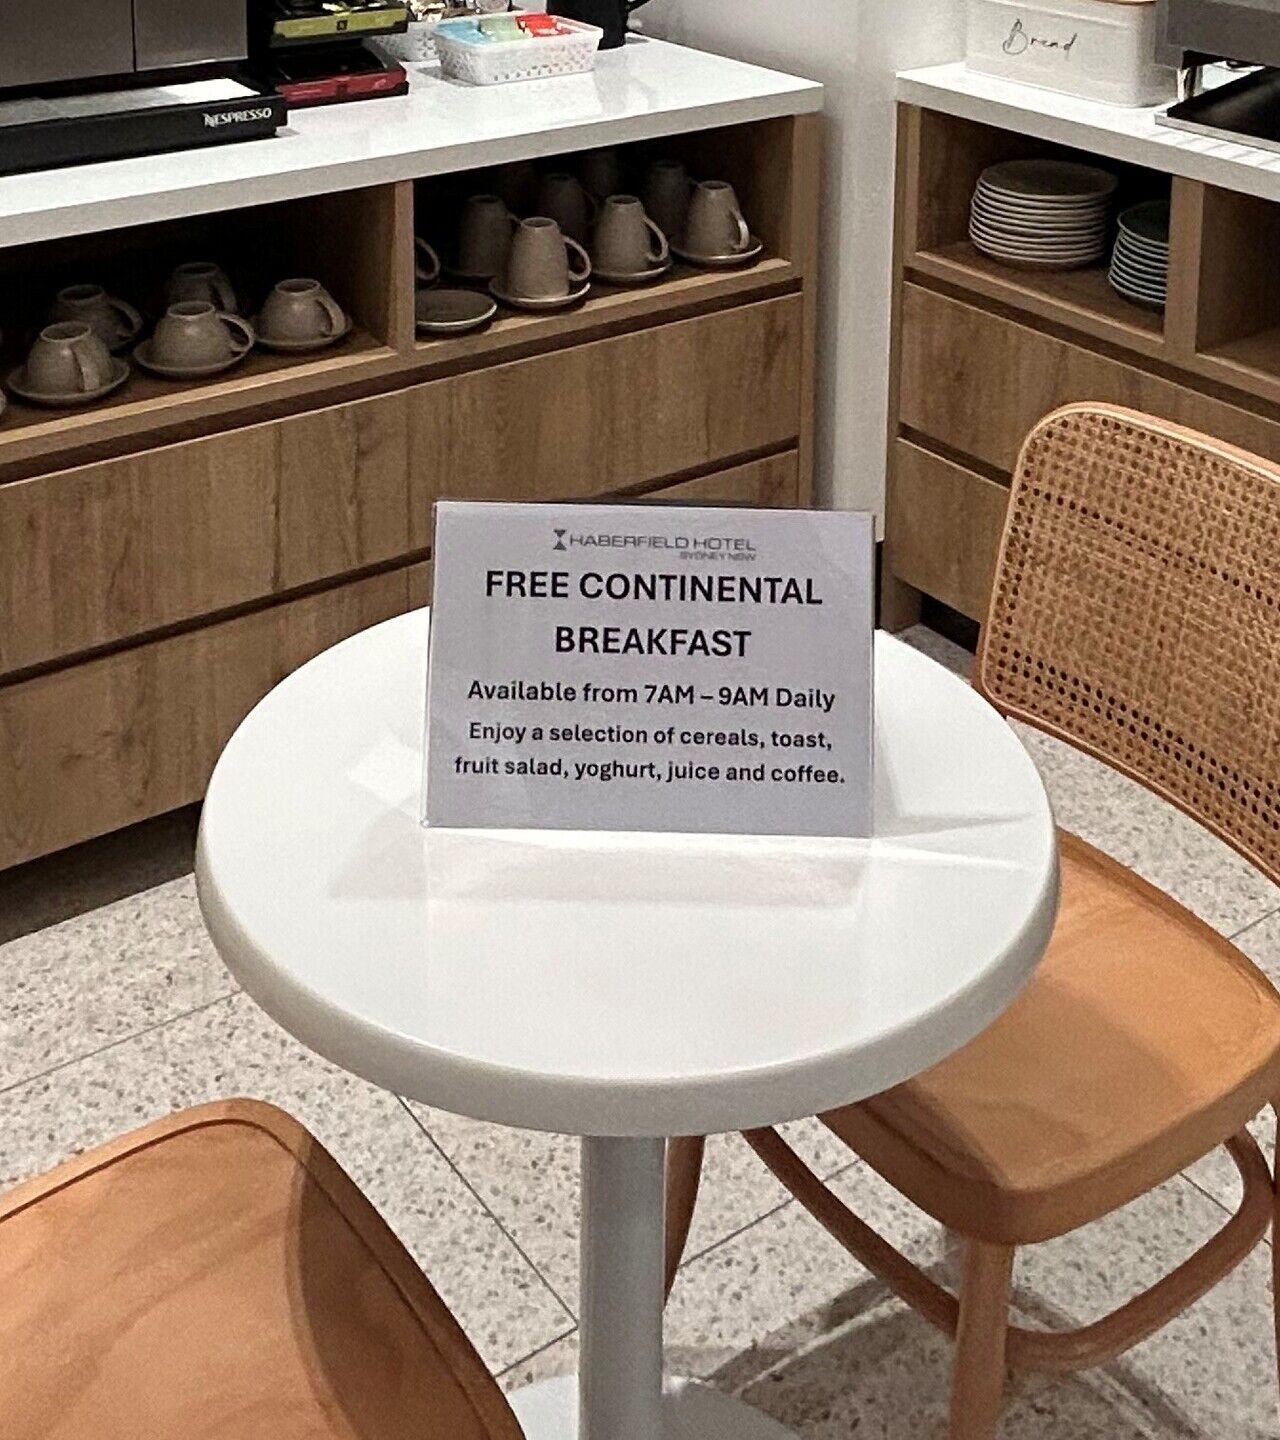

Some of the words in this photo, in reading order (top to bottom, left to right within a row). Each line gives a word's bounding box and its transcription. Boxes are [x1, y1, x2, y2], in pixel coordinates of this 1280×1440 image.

[1003, 19, 1078, 61] Bread
[203, 108, 272, 127] NESPRESSO
[569, 534, 689, 550] HABERFIELD
[693, 537, 756, 552] HOTEL
[485, 570, 569, 598] FREE
[579, 573, 823, 605] CONTINENTAL
[555, 626, 752, 658] BREAKFAST
[468, 681, 576, 703] Available
[583, 684, 637, 704] from
[644, 684, 695, 705] 7AM
[718, 686, 769, 707] 9AM
[776, 688, 836, 713] Daily
[469, 723, 526, 744] Enjoy
[531, 729, 544, 742] a
[549, 724, 648, 744] selection
[653, 726, 675, 745] of
[680, 728, 766, 749] cereals,
[771, 730, 833, 751] toast,
[455, 757, 499, 776] fruit
[504, 758, 569, 778] salad,
[574, 760, 662, 781] yoghurt,
[666, 762, 719, 782] juice
[725, 764, 765, 782] and
[771, 765, 846, 784] coffee.
